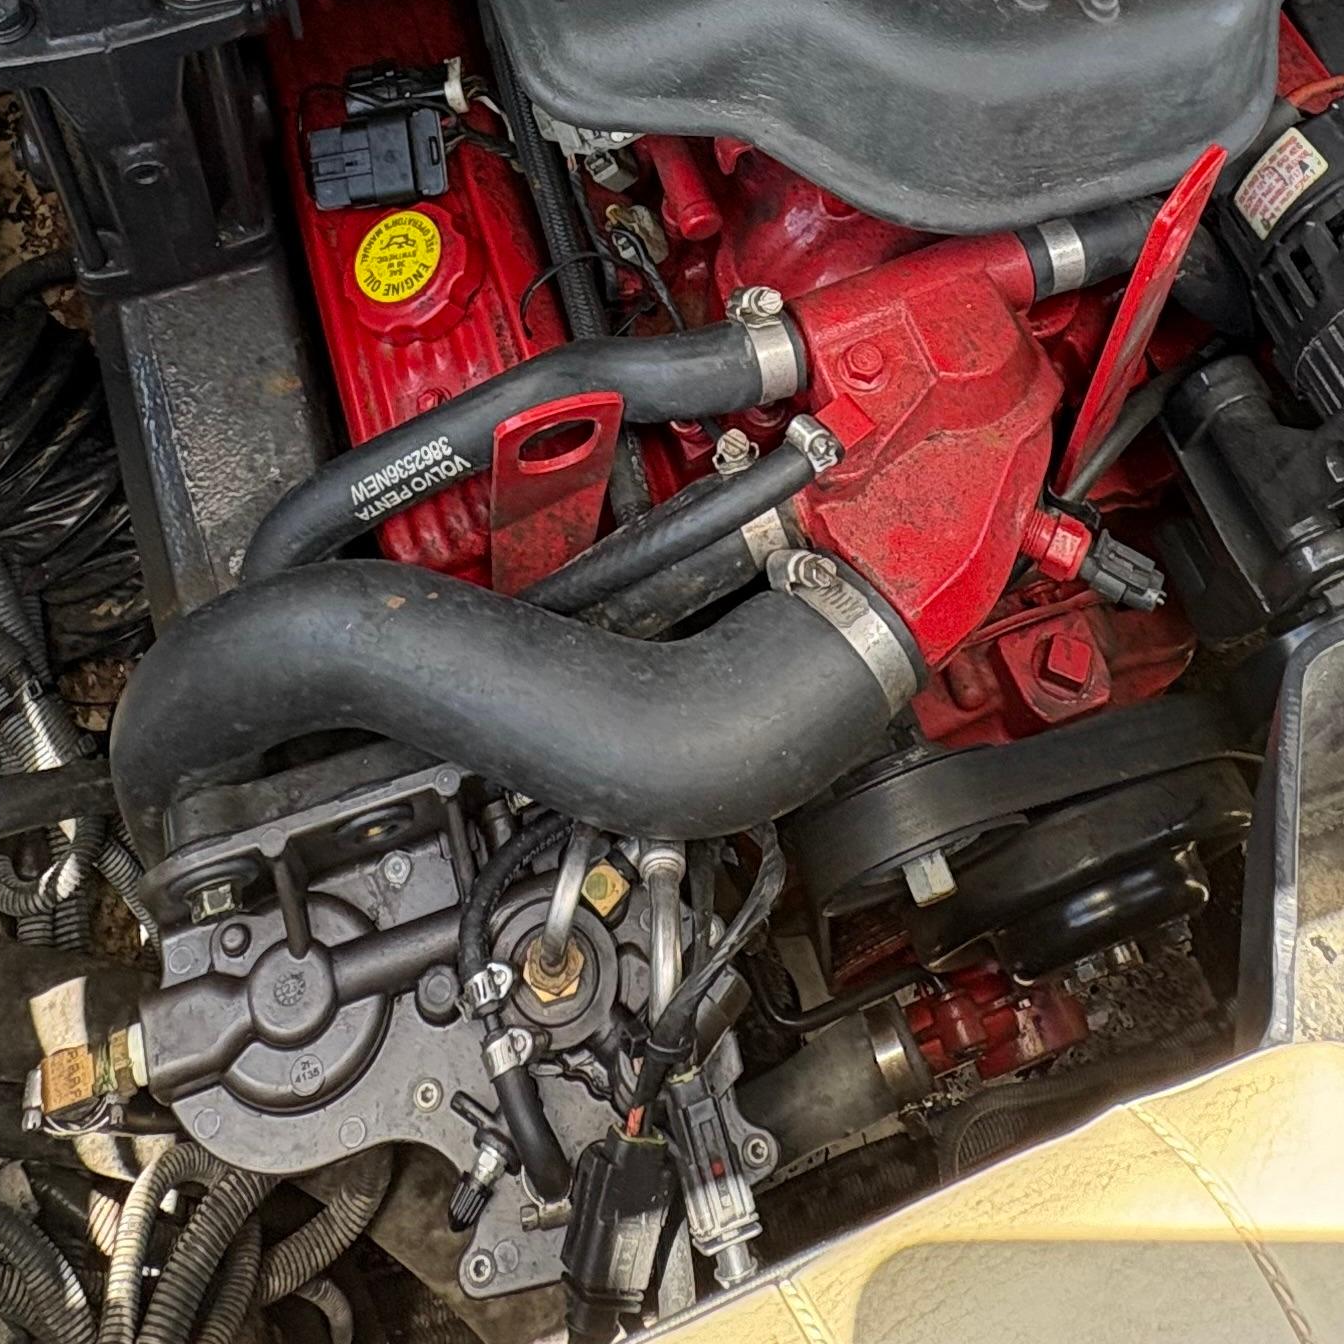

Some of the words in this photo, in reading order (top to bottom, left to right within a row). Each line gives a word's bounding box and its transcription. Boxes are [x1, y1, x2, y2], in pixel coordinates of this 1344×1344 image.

[360, 228, 383, 265] MANUAL
[376, 250, 416, 263] SYNTHETIC
[424, 233, 435, 253] SEE
[363, 269, 382, 292] OIL
[383, 262, 432, 296] ENGINE
[350, 436, 453, 506] 3862536NEW
[410, 454, 472, 492] VOLVO
[354, 484, 413, 521] PENTA
